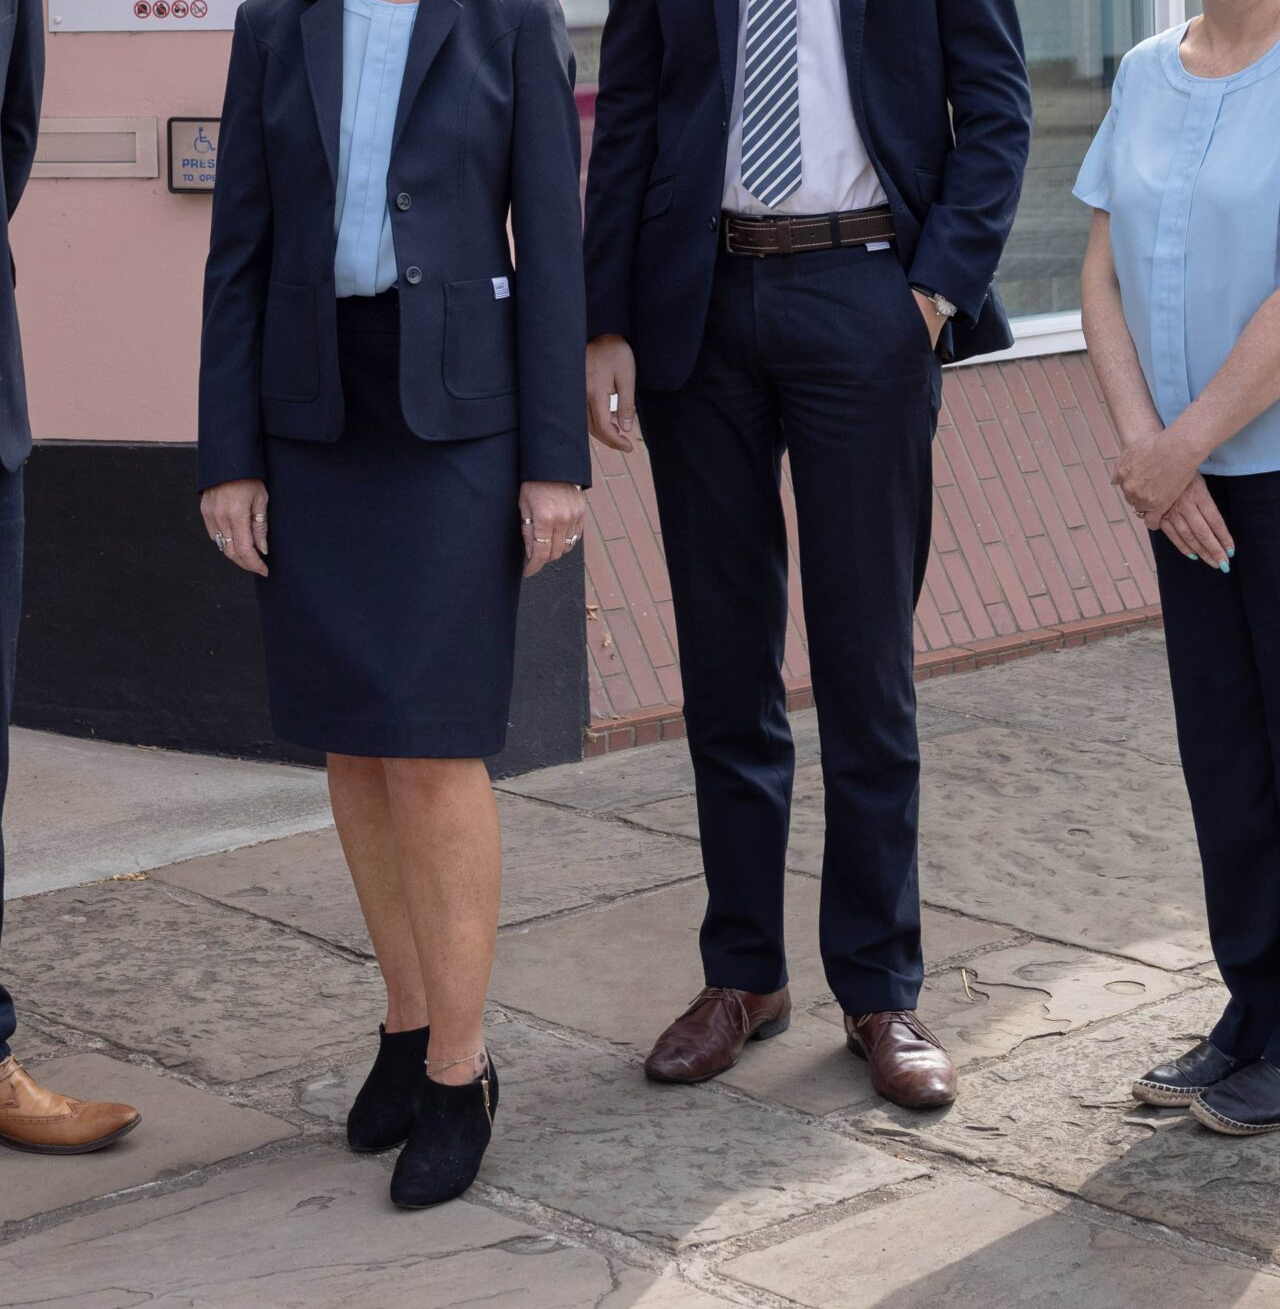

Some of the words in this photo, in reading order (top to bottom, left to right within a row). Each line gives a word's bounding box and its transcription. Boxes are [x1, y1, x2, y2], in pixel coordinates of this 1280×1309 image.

[182, 158, 216, 169] PRES
[182, 174, 194, 182] TO
[199, 174, 217, 182] OPE
